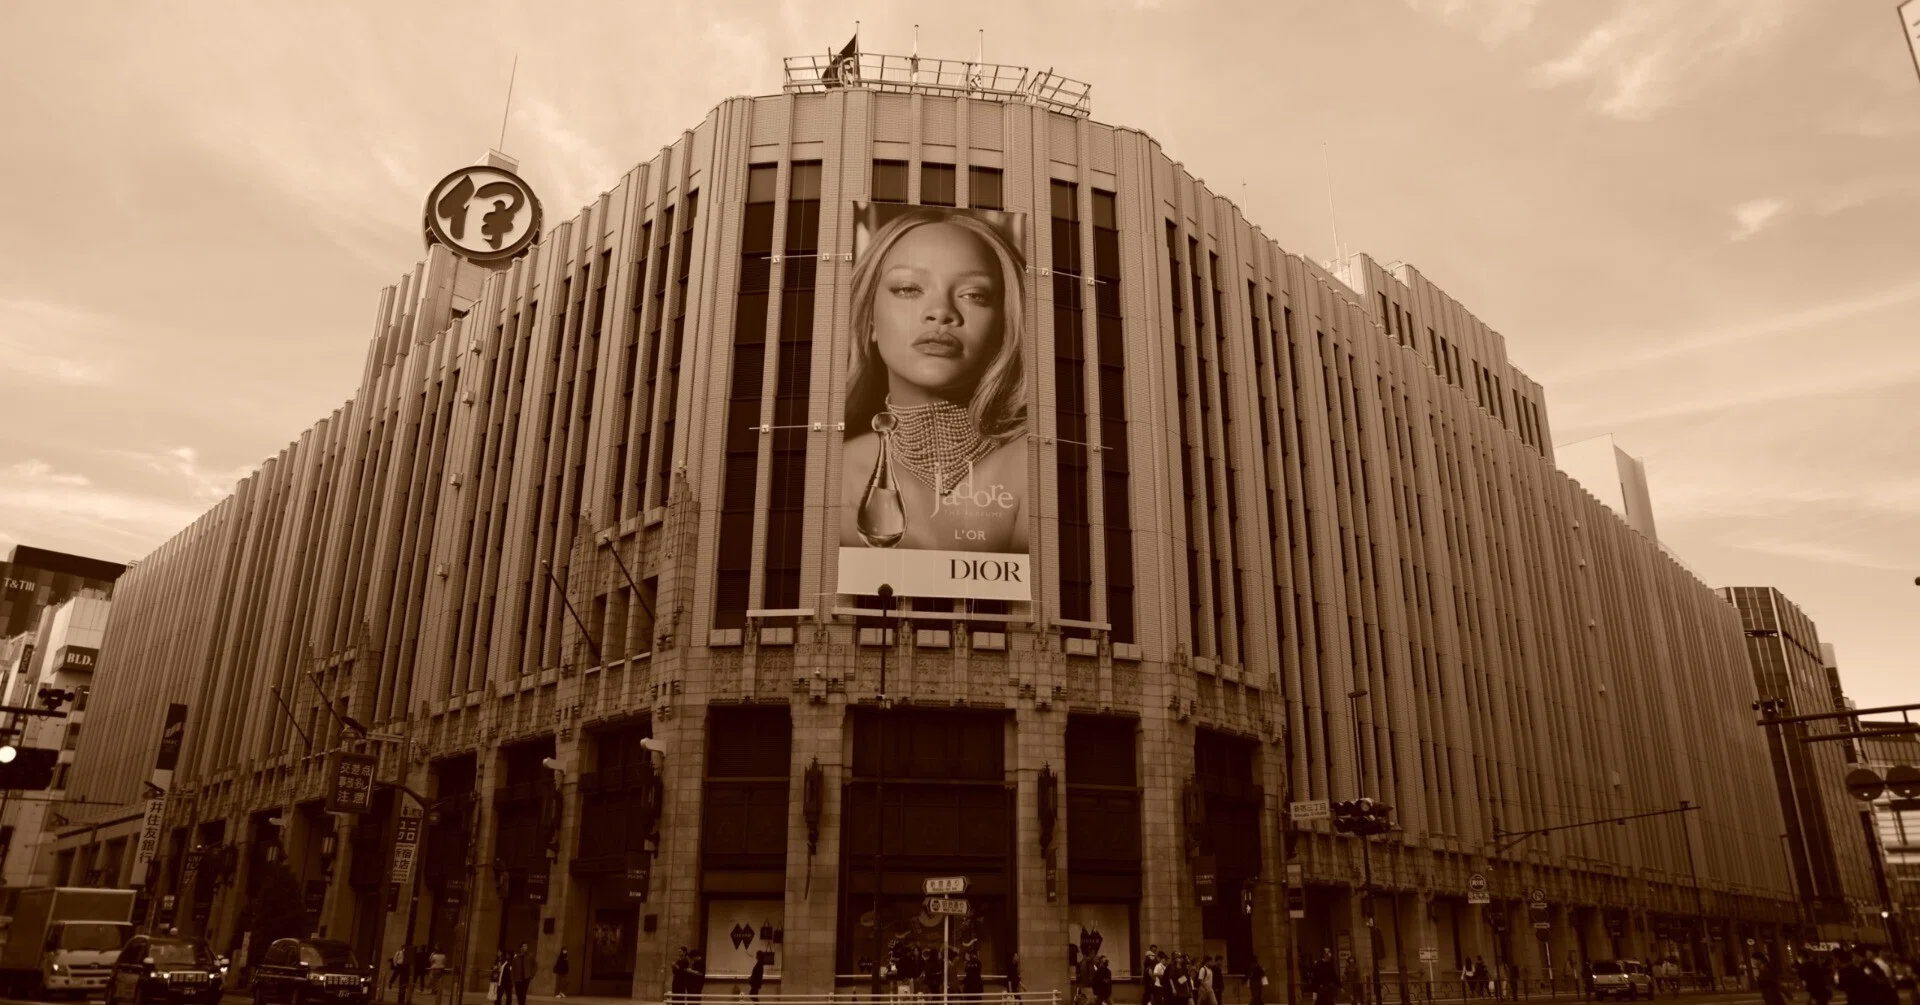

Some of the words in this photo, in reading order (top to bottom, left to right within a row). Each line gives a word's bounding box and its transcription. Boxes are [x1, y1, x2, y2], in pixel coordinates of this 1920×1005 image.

[954, 529, 986, 541] L'OR
[949, 559, 1022, 583] DIOR
[67, 653, 94, 667] BLD.
[340, 762, 371, 776] 交差点
